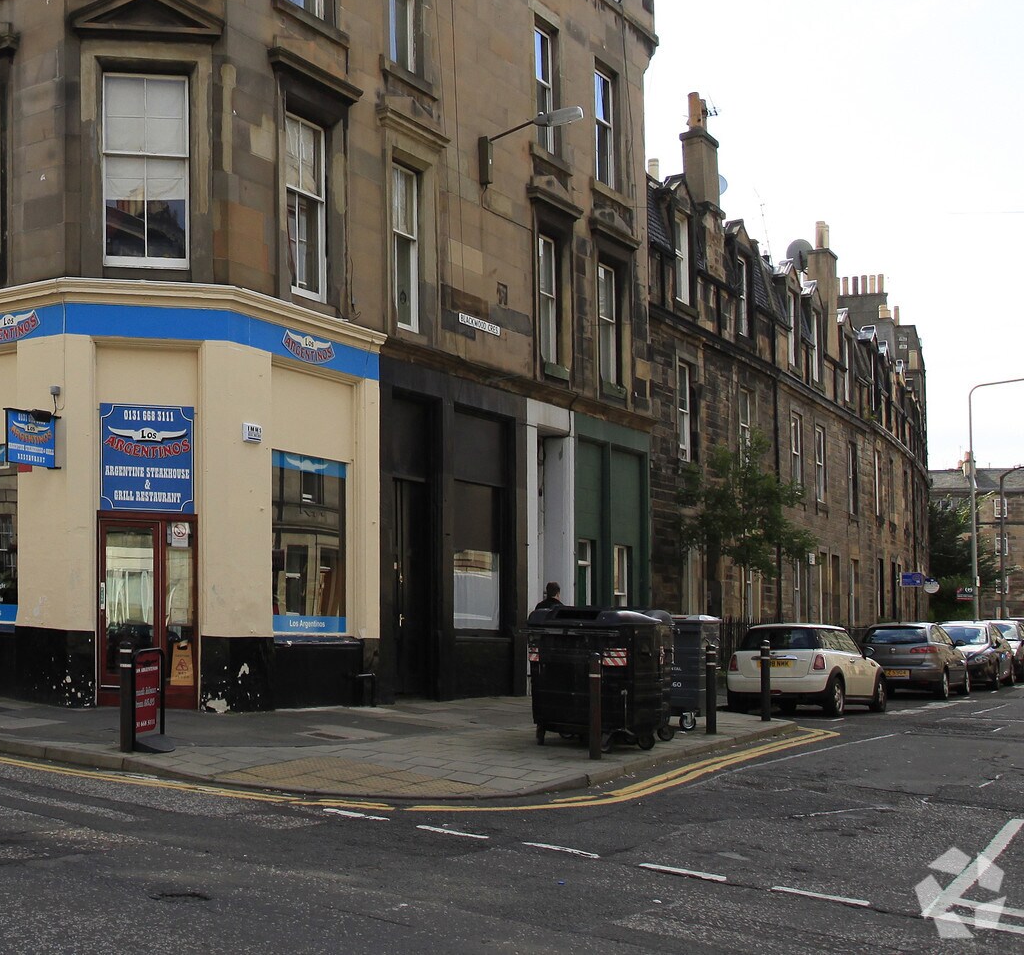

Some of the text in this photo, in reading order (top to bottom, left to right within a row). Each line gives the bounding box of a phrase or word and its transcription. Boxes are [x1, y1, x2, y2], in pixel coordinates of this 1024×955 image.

[3, 317, 14, 326] Los
[305, 337, 315, 348] Los
[285, 337, 333, 362] ARGENTINOS
[123, 410, 174, 422] 0131 668 3111
[140, 429, 157, 439] Los
[104, 435, 190, 459] ARGENTINOS
[105, 465, 190, 479] ARGENTINE STEAKHOUSE
[144, 479, 151, 490] &
[114, 490, 182, 503] GRILL RESTAURANT
[289, 619, 326, 629] Los Argentinos
